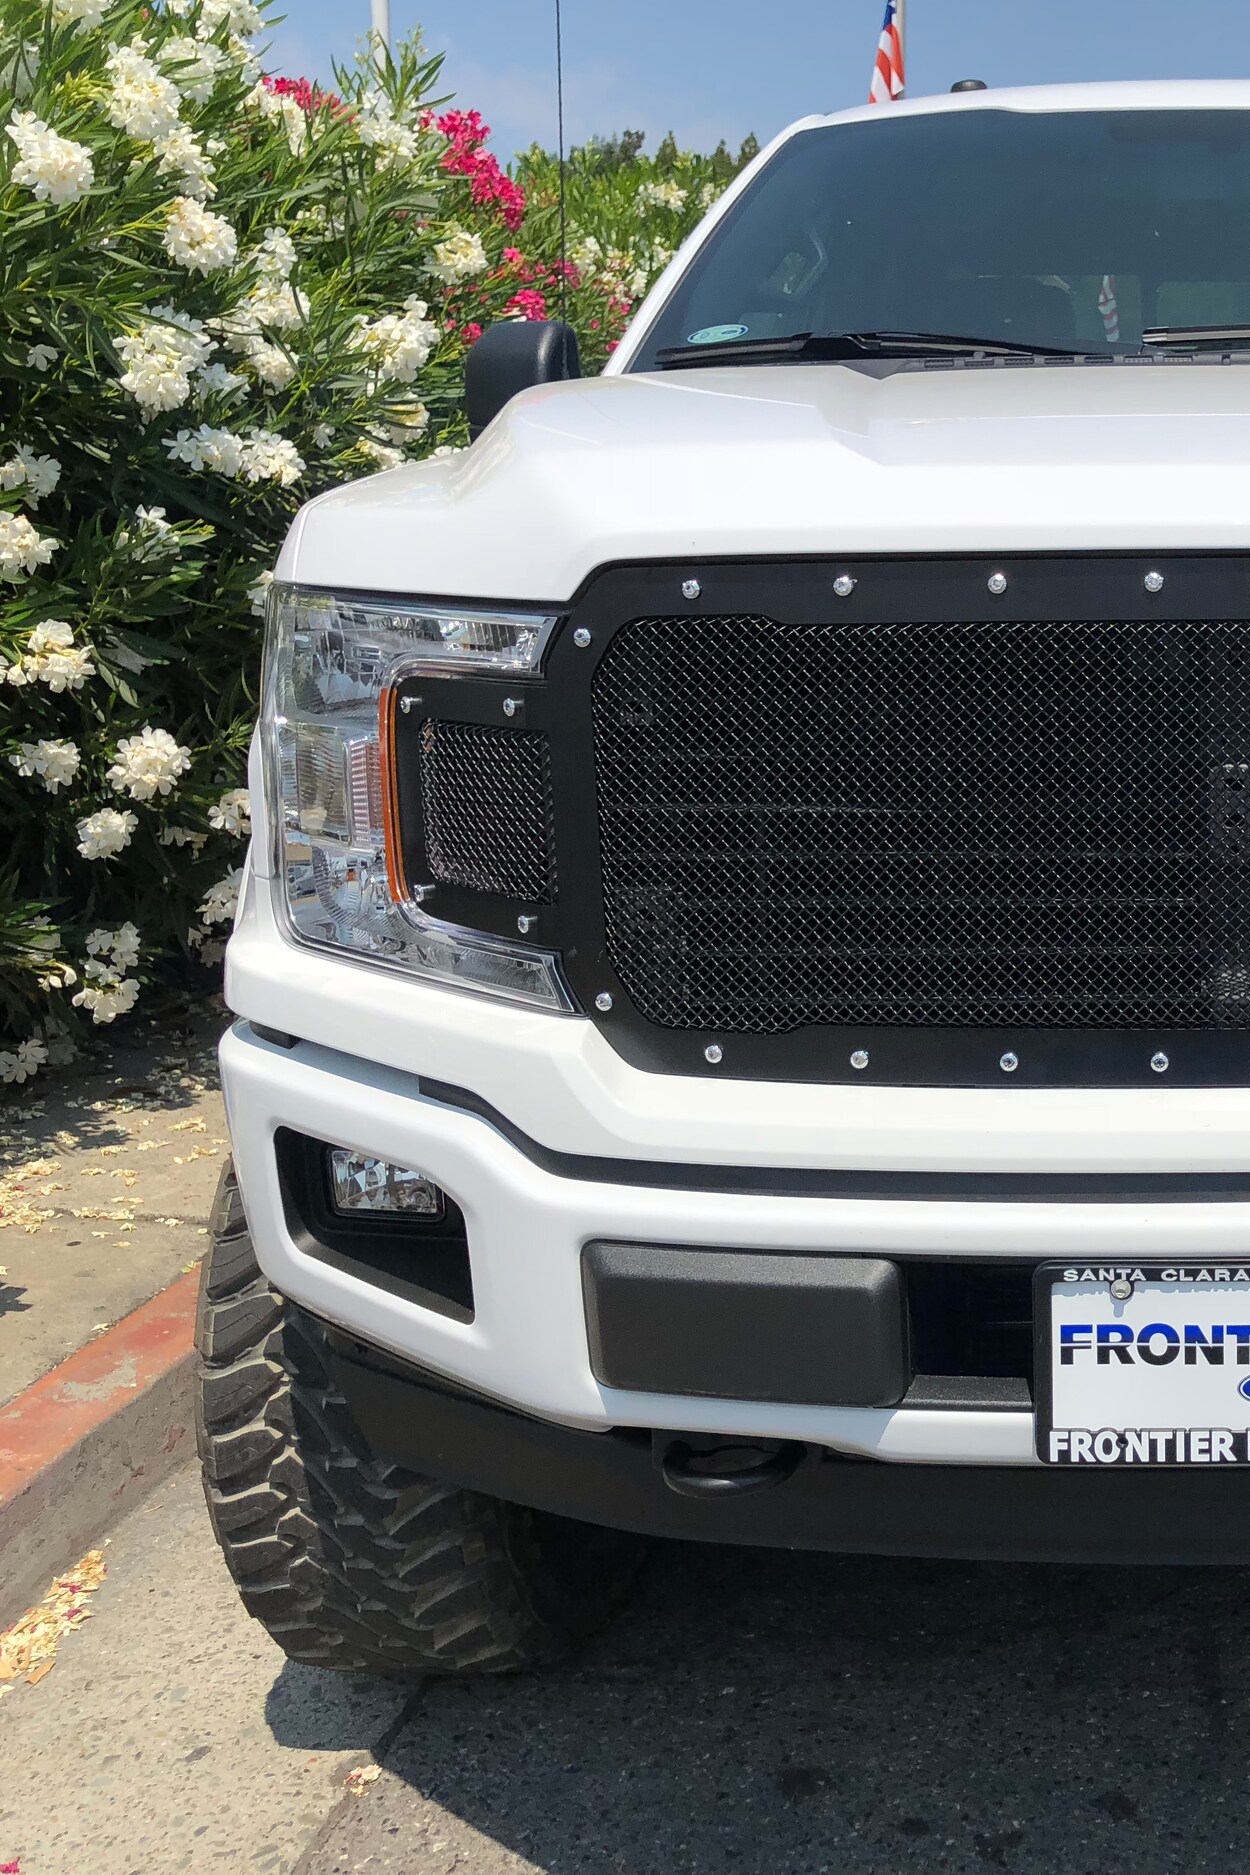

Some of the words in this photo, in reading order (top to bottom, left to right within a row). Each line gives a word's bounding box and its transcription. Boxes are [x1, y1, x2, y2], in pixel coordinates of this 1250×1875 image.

[1063, 1268, 1147, 1282] SANTA
[1160, 1268, 1250, 1282] CLARA
[1049, 1430, 1237, 1463] FRONTIER
